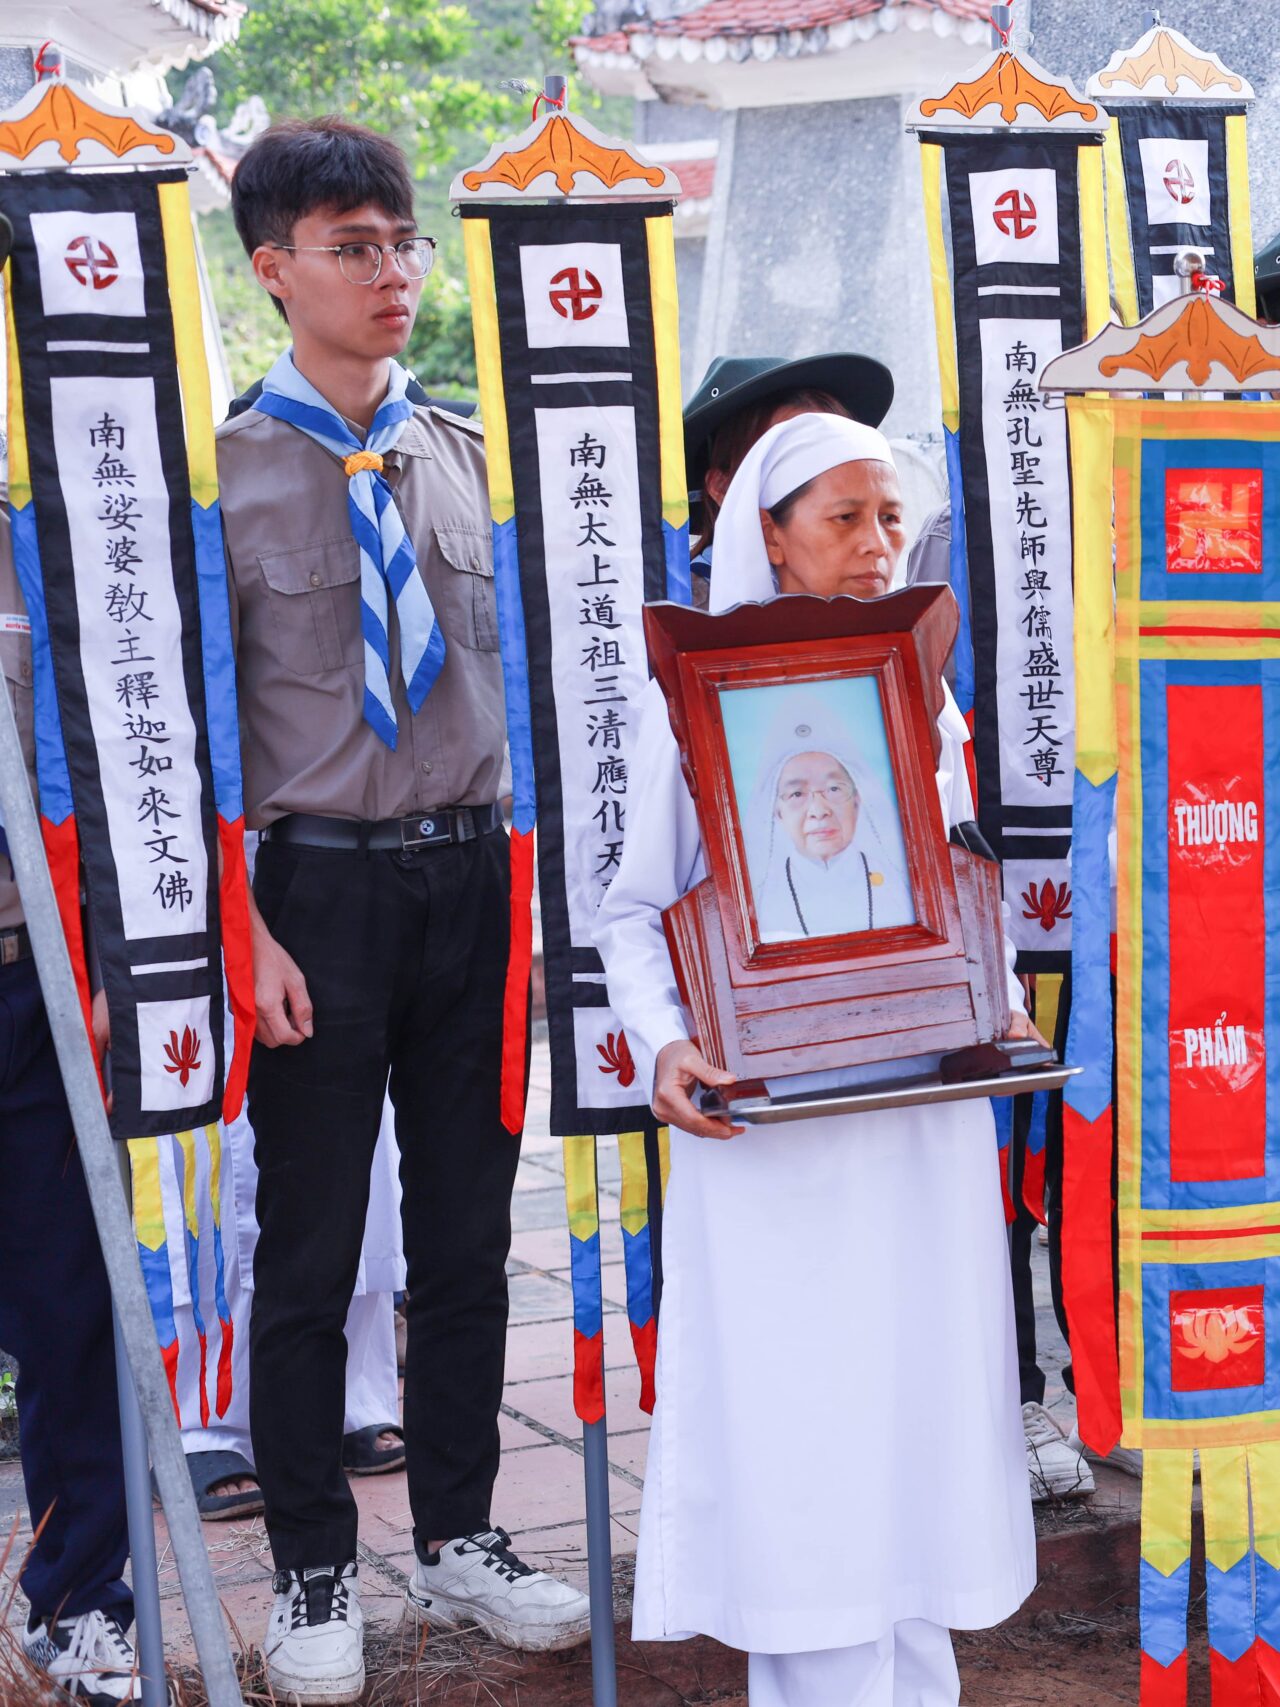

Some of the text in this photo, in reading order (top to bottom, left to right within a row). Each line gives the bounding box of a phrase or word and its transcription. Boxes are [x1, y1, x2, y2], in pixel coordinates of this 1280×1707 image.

[569, 432, 628, 907] 南無太上道祖三清應化天
[1174, 799, 1259, 851] THƯỢNG
[1183, 1011, 1249, 1069] PHẨM
